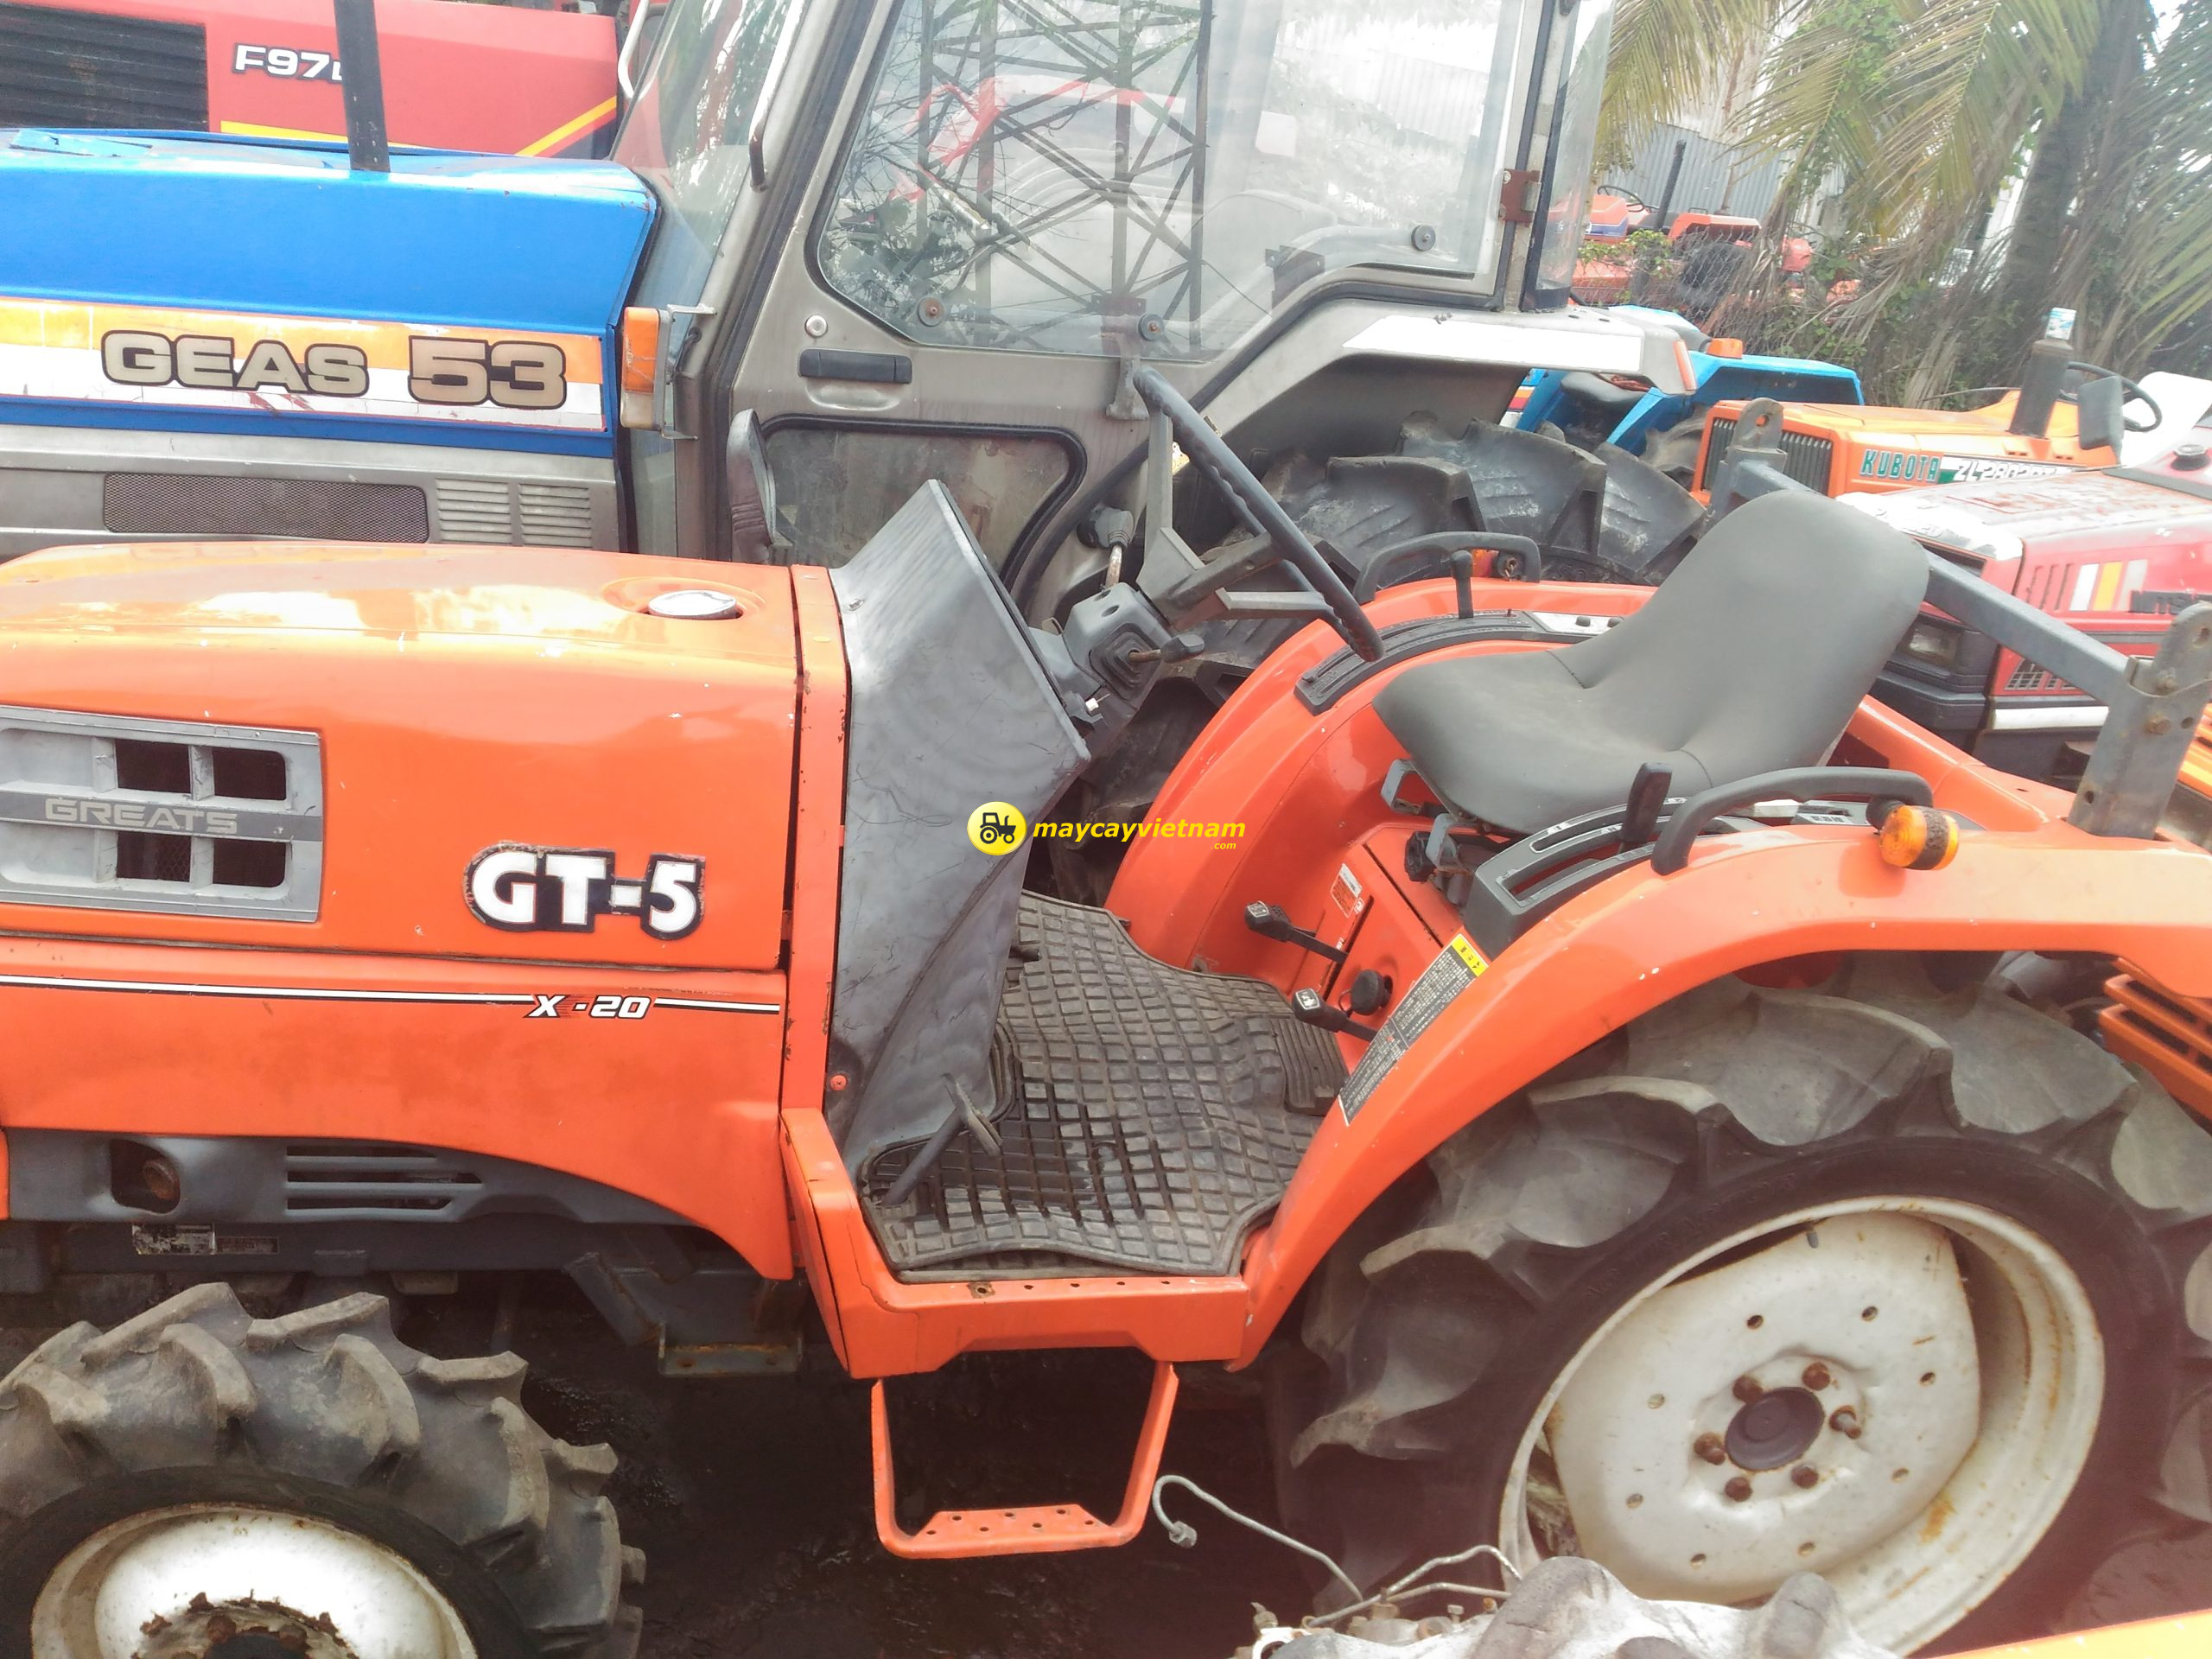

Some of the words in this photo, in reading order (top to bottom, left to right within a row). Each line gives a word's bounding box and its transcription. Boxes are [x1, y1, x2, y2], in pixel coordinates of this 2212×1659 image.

[101, 330, 368, 397] GEAS
[409, 335, 567, 410] 53
[1860, 449, 1941, 482] KUBOTA
[45, 798, 238, 835] GREATS
[465, 842, 703, 939] GT-5
